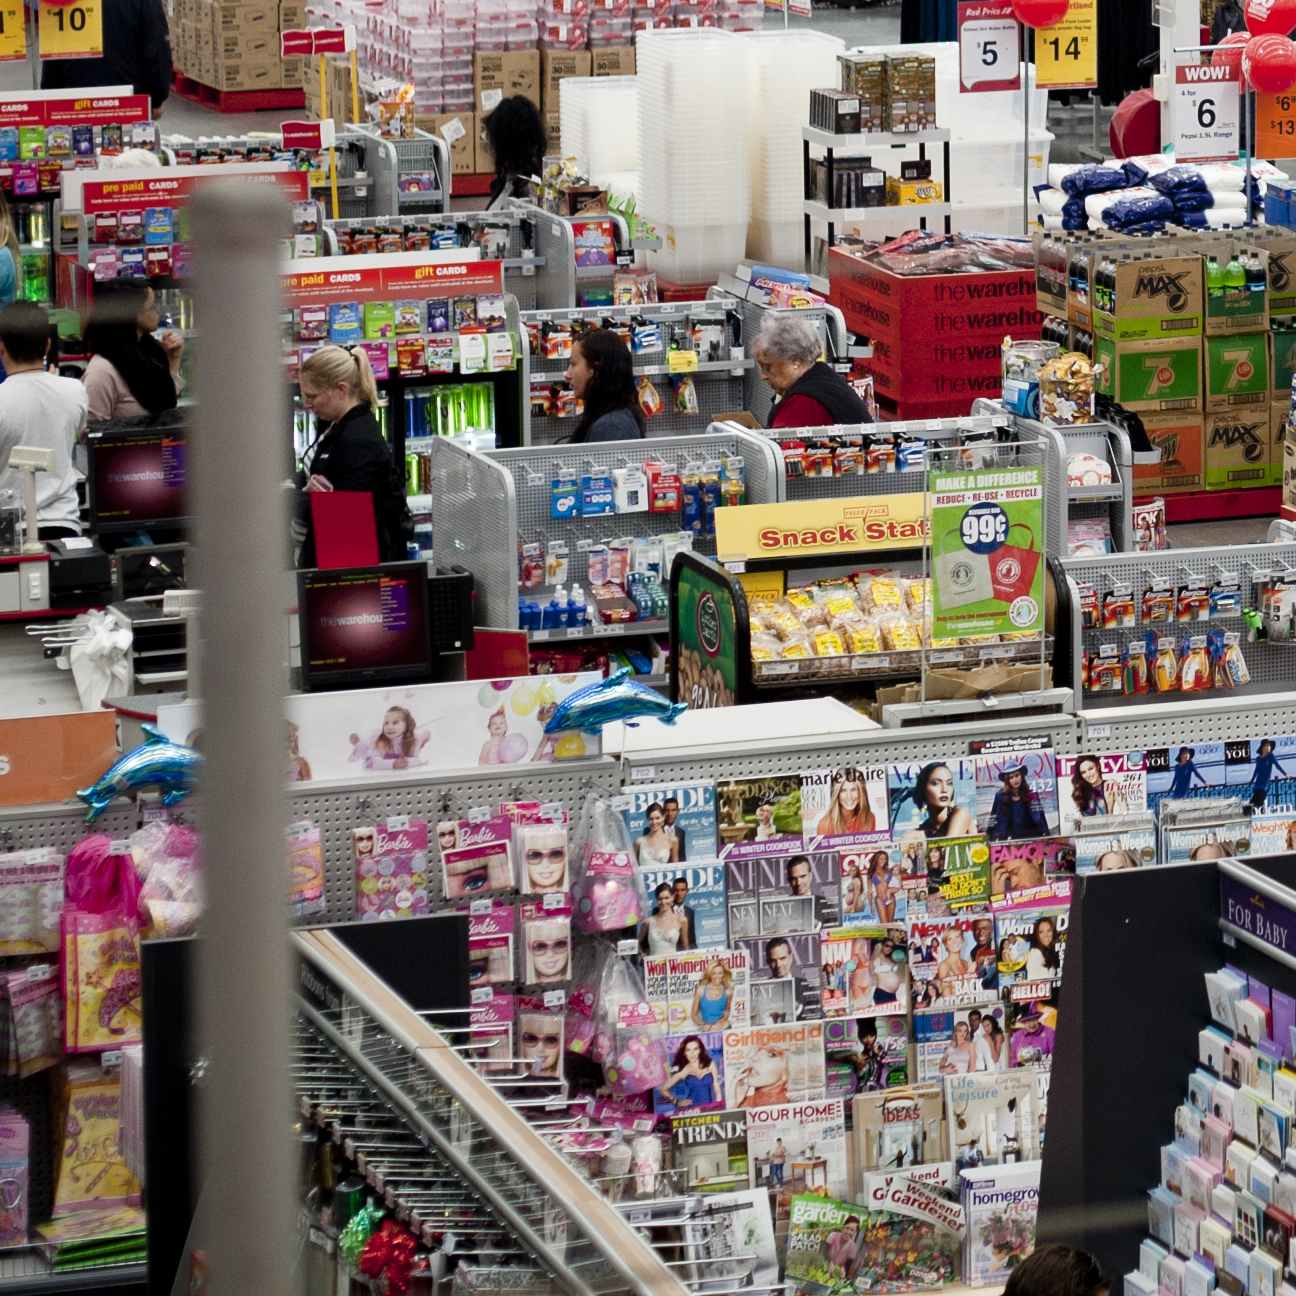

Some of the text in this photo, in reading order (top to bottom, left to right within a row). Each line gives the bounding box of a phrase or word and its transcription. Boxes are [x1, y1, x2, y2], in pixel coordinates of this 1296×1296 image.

[74, 99, 119, 111] gift CARDS
[415, 265, 467, 279] gift CARDS
[1135, 271, 1191, 298] MAX
[936, 470, 1038, 492] MAKE A DIFFERENCE
[937, 488, 1037, 505] REDUCE RECYCLE
[760, 525, 855, 548] Snack
[802, 766, 884, 786] marie claire
[629, 789, 713, 812] BRIDE
[1215, 827, 1250, 845] Weekly
[1228, 904, 1288, 949] FOR BABY
[1011, 983, 1050, 1001] HELLO!
[726, 1029, 805, 1048] Girlfriend
[672, 1115, 720, 1128] KITCHEN
[748, 1105, 834, 1123] YOUR HOME
[674, 1120, 747, 1144] TRENDS
[891, 1189, 965, 1233] Gardener
[905, 1183, 962, 1219] Weekend
